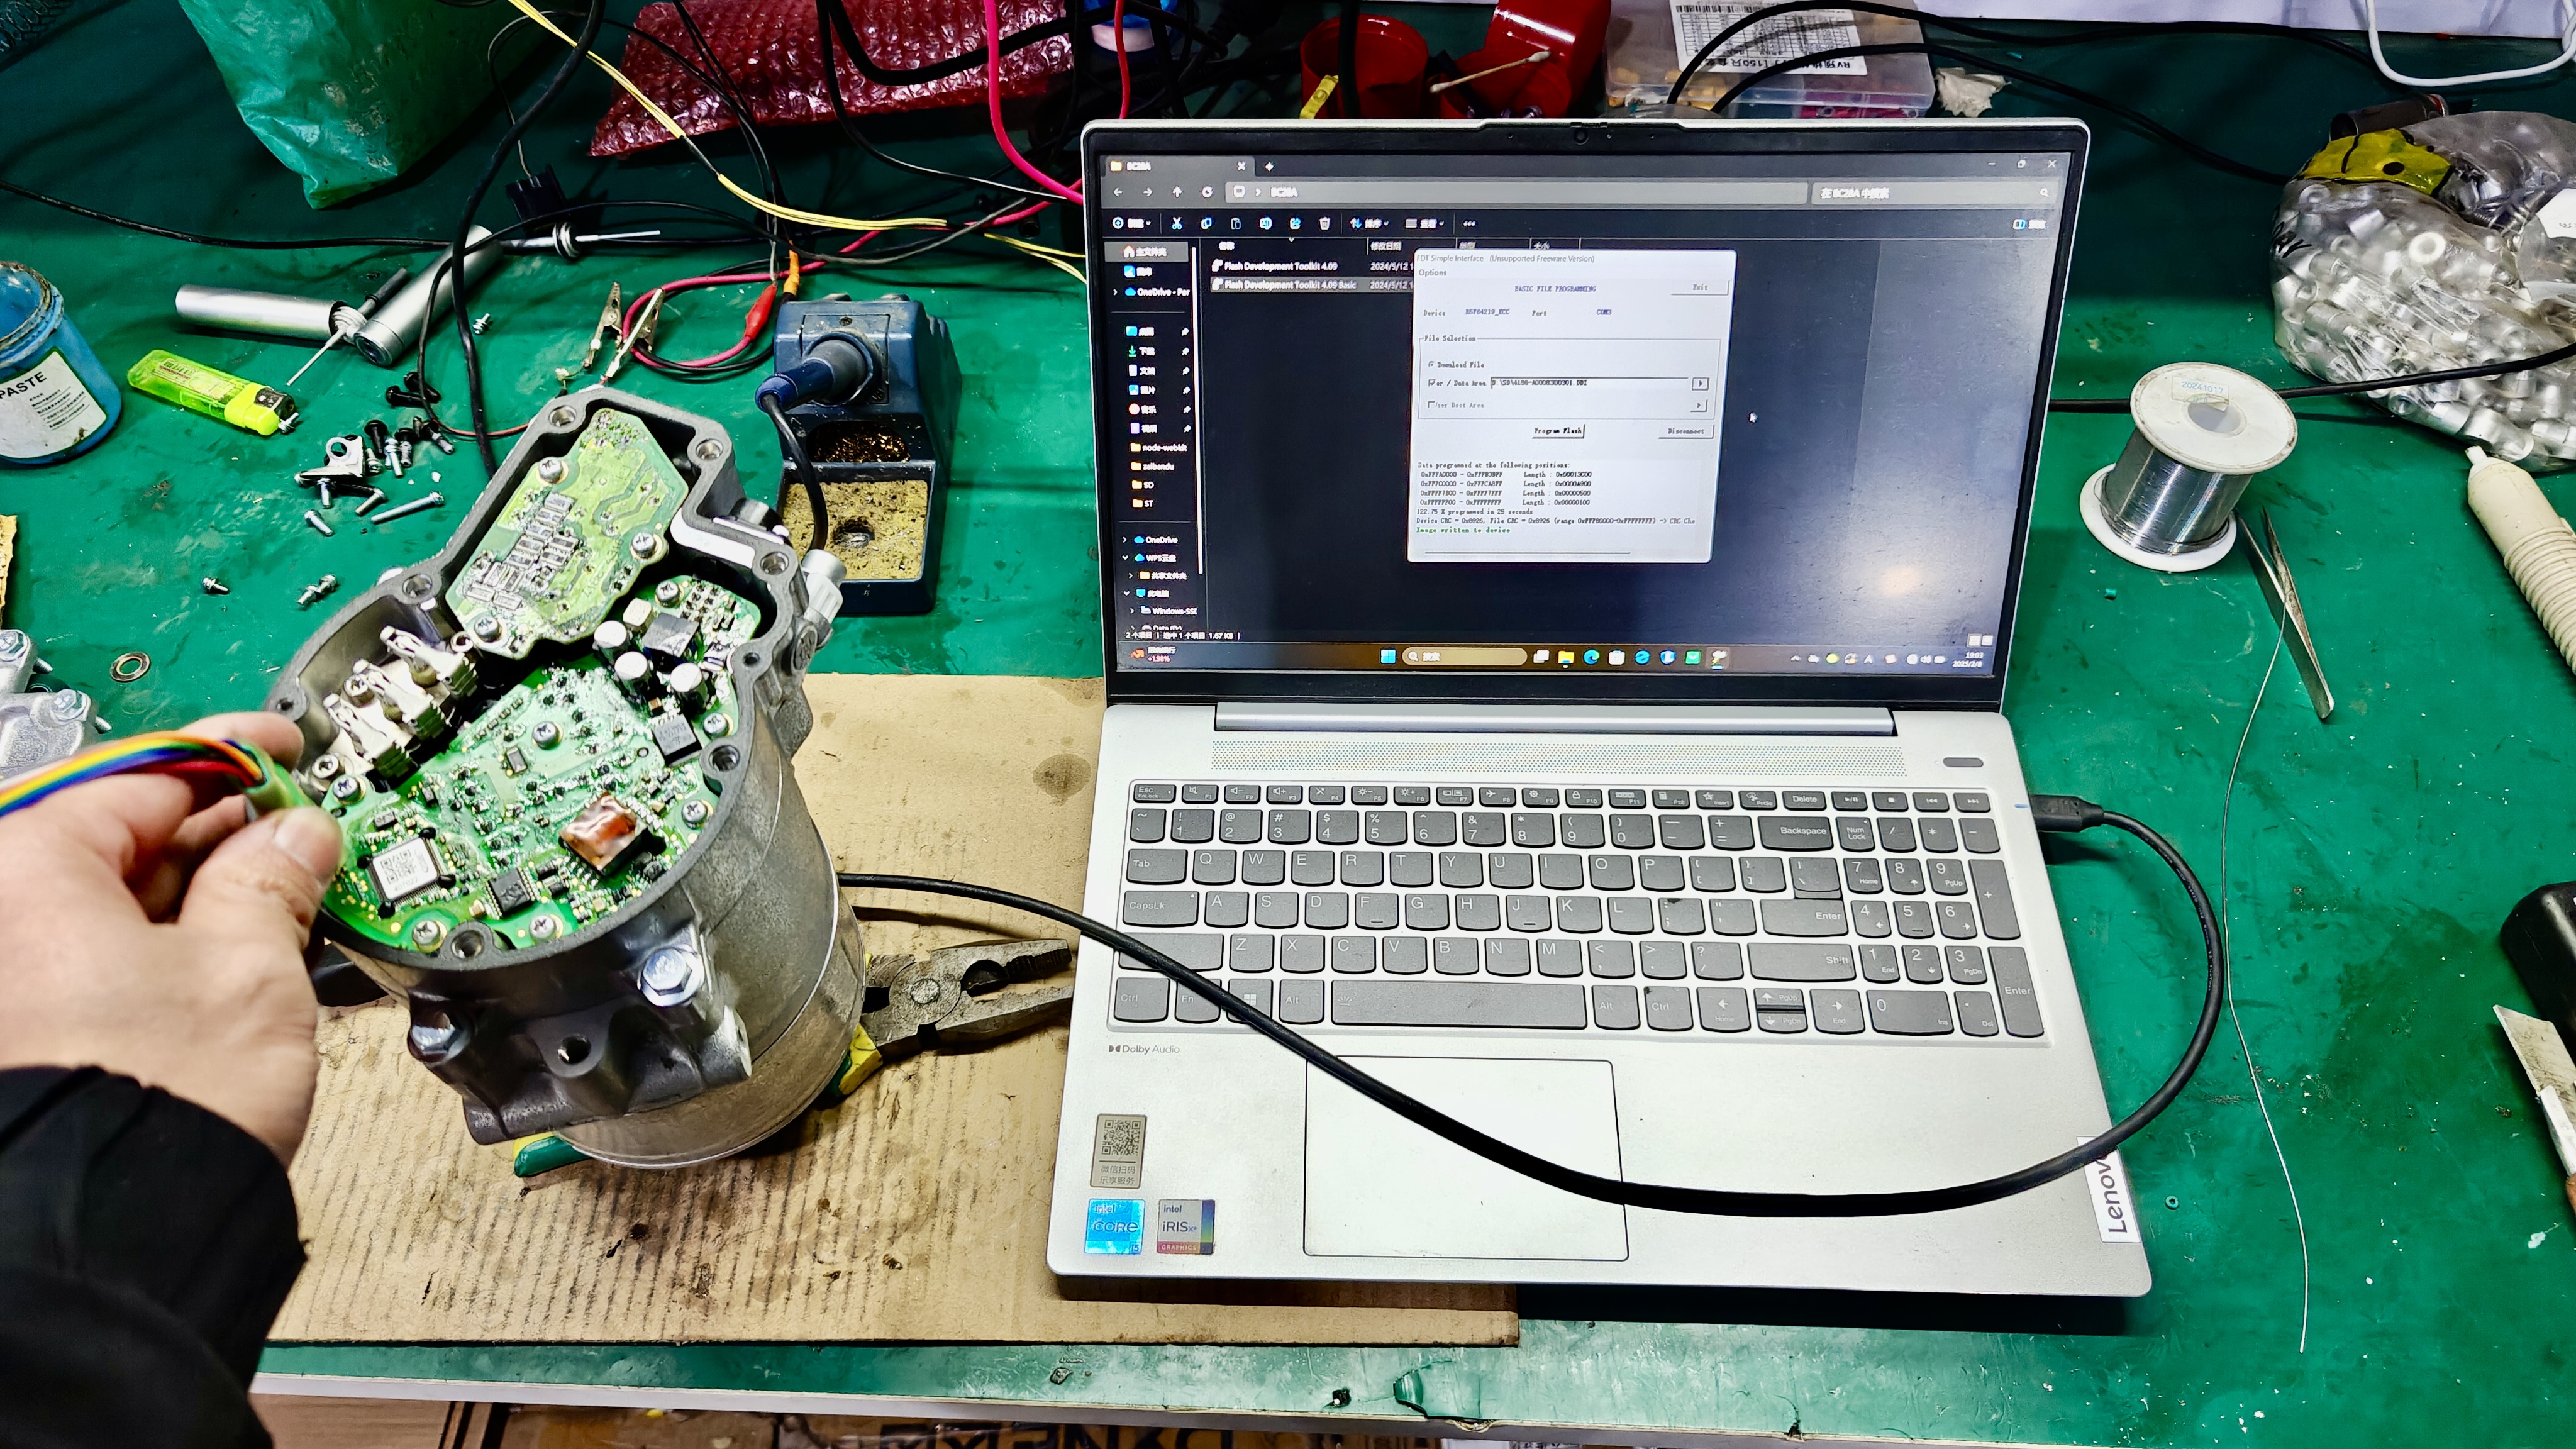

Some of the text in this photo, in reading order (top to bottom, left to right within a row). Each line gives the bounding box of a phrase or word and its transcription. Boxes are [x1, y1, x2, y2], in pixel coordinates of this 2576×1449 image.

[1431, 255, 1453, 263] Simple
[1490, 255, 1536, 263] (Unsupported
[1568, 255, 1595, 263] Version)
[1224, 262, 1338, 272] Flash Development Toolkit 4.09
[1419, 269, 1447, 278] Options
[1224, 280, 1357, 291] Flash Development Toolkit 4.09 Basic
[1137, 288, 1171, 296] OneDrive
[0, 372, 47, 401] PASTE
[2182, 381, 2223, 394] 20241017
[1143, 443, 1187, 452] node-webkit
[1500, 462, 1533, 470] following
[1535, 462, 1570, 470] positions:
[1143, 481, 1154, 489] SD
[1144, 499, 1153, 508] ST
[1145, 536, 1178, 544] OneDrive
[1780, 826, 1827, 836] Backspace
[1133, 859, 1150, 867] Tab
[1199, 853, 1213, 866] Q
[1248, 853, 1264, 865] W
[1297, 854, 1307, 865] E
[1346, 855, 1357, 866] R
[1395, 855, 1407, 866] T
[1445, 855, 1456, 867] Y
[1494, 856, 1505, 868] U
[1595, 858, 1608, 870] O
[1645, 858, 1655, 870] P
[1129, 901, 1165, 911] CapsLk
[1211, 896, 1223, 908] A
[1260, 896, 1272, 908] S
[1311, 896, 1322, 908] D
[1360, 896, 1370, 908] F
[1411, 897, 1424, 909] G
[1461, 897, 1472, 909] H
[1512, 899, 1521, 911] J
[1613, 901, 1623, 913] L
[1816, 911, 1841, 920] Enter
[1236, 939, 1246, 951] Z
[1287, 939, 1297, 951] X
[1337, 940, 1350, 952] C
[1389, 940, 1400, 952] V
[1439, 941, 1450, 953] B
[1491, 941, 1502, 954] N
[1543, 942, 1556, 955] M
[1826, 955, 1849, 964] Shift
[2004, 986, 2031, 996] Enter
[1120, 994, 1138, 1003] Ctrl
[1285, 996, 1299, 1004] Alt
[1122, 1044, 1180, 1055] Dolby Audio
[1101, 1165, 1136, 1175] 微信扫码
[1099, 1176, 1135, 1185] 乐享服务
[2096, 1155, 2128, 1233] Lenov
[1163, 1204, 1182, 1213] intel
